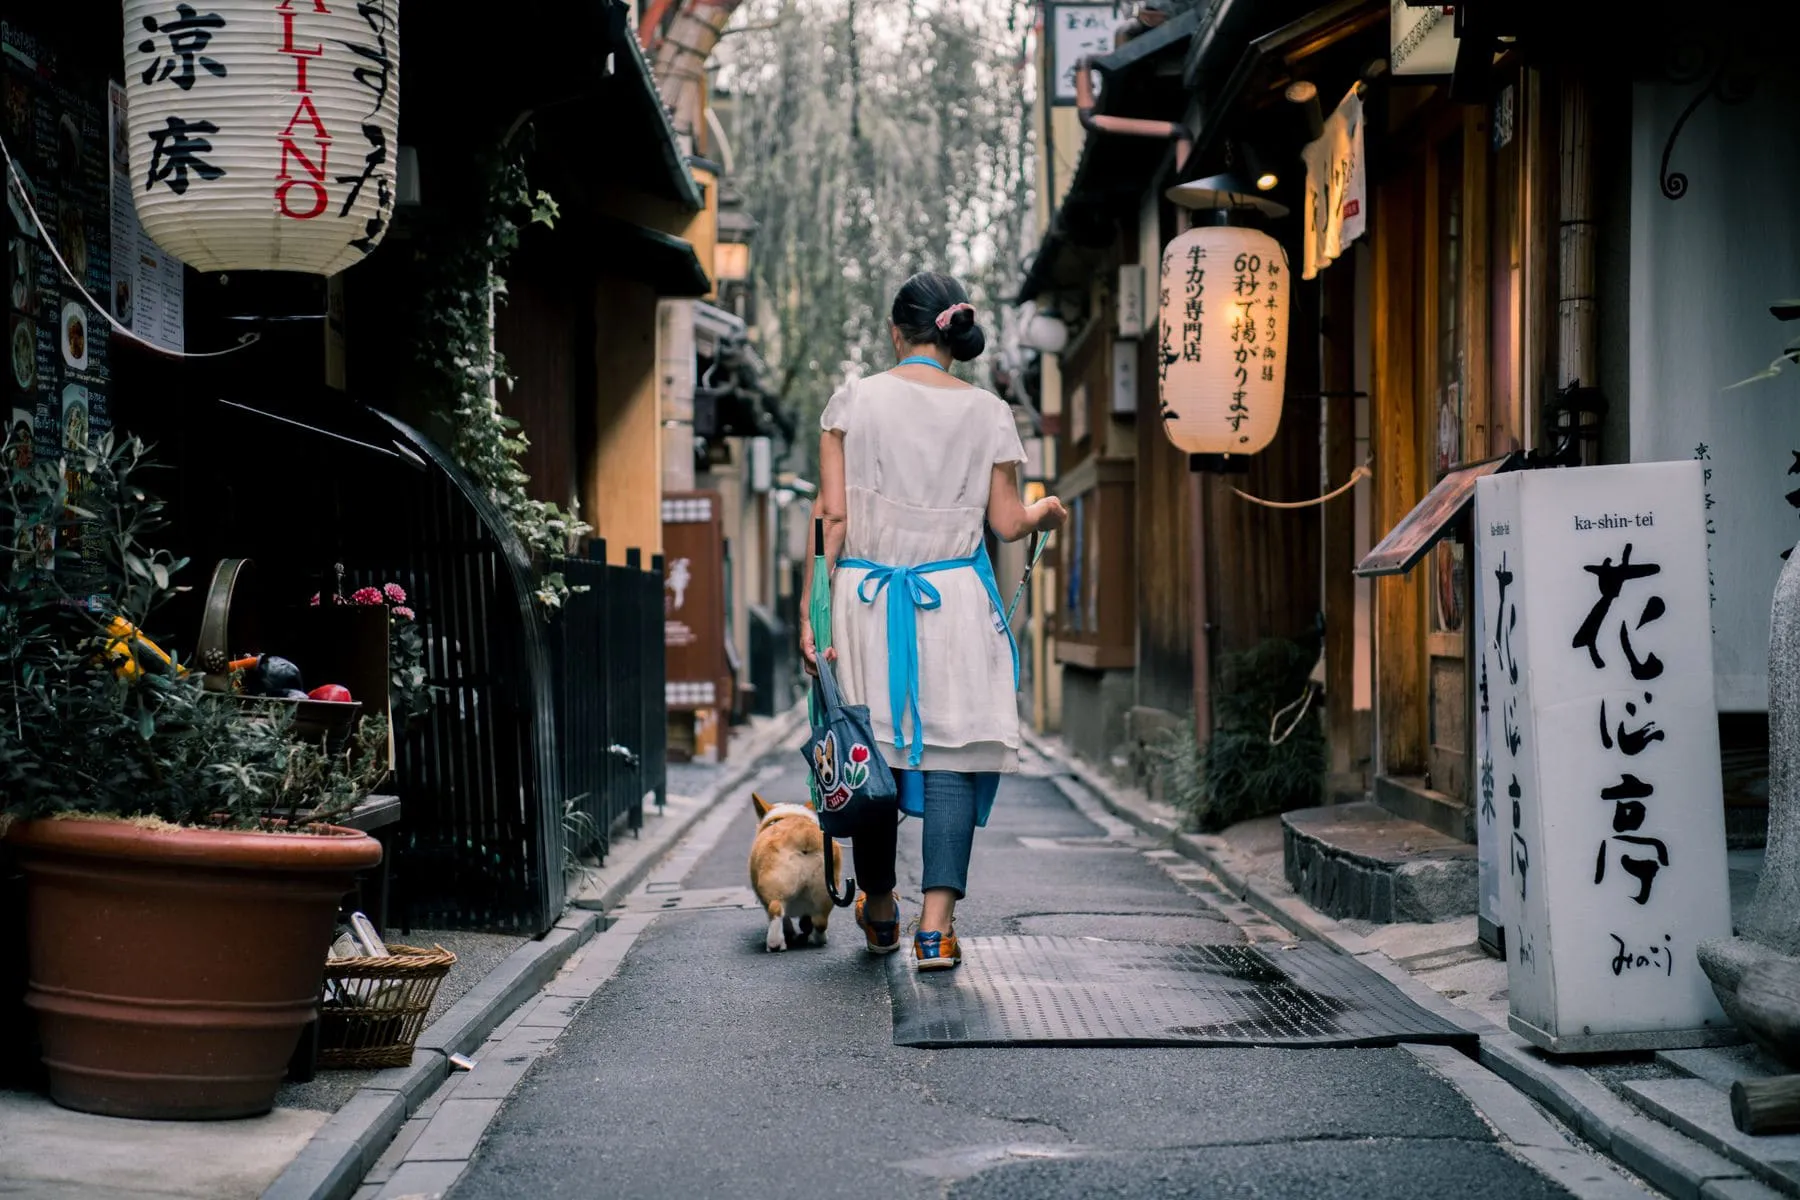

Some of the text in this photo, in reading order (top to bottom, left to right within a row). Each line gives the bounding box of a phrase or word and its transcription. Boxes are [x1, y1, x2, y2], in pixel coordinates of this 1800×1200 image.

[138, 3, 227, 195] 涼床
[1182, 245, 1206, 363] 牛カツ専門店
[1225, 252, 1260, 444] 60秒で揚がります。
[1574, 511, 1654, 530] ka-shin-tei
